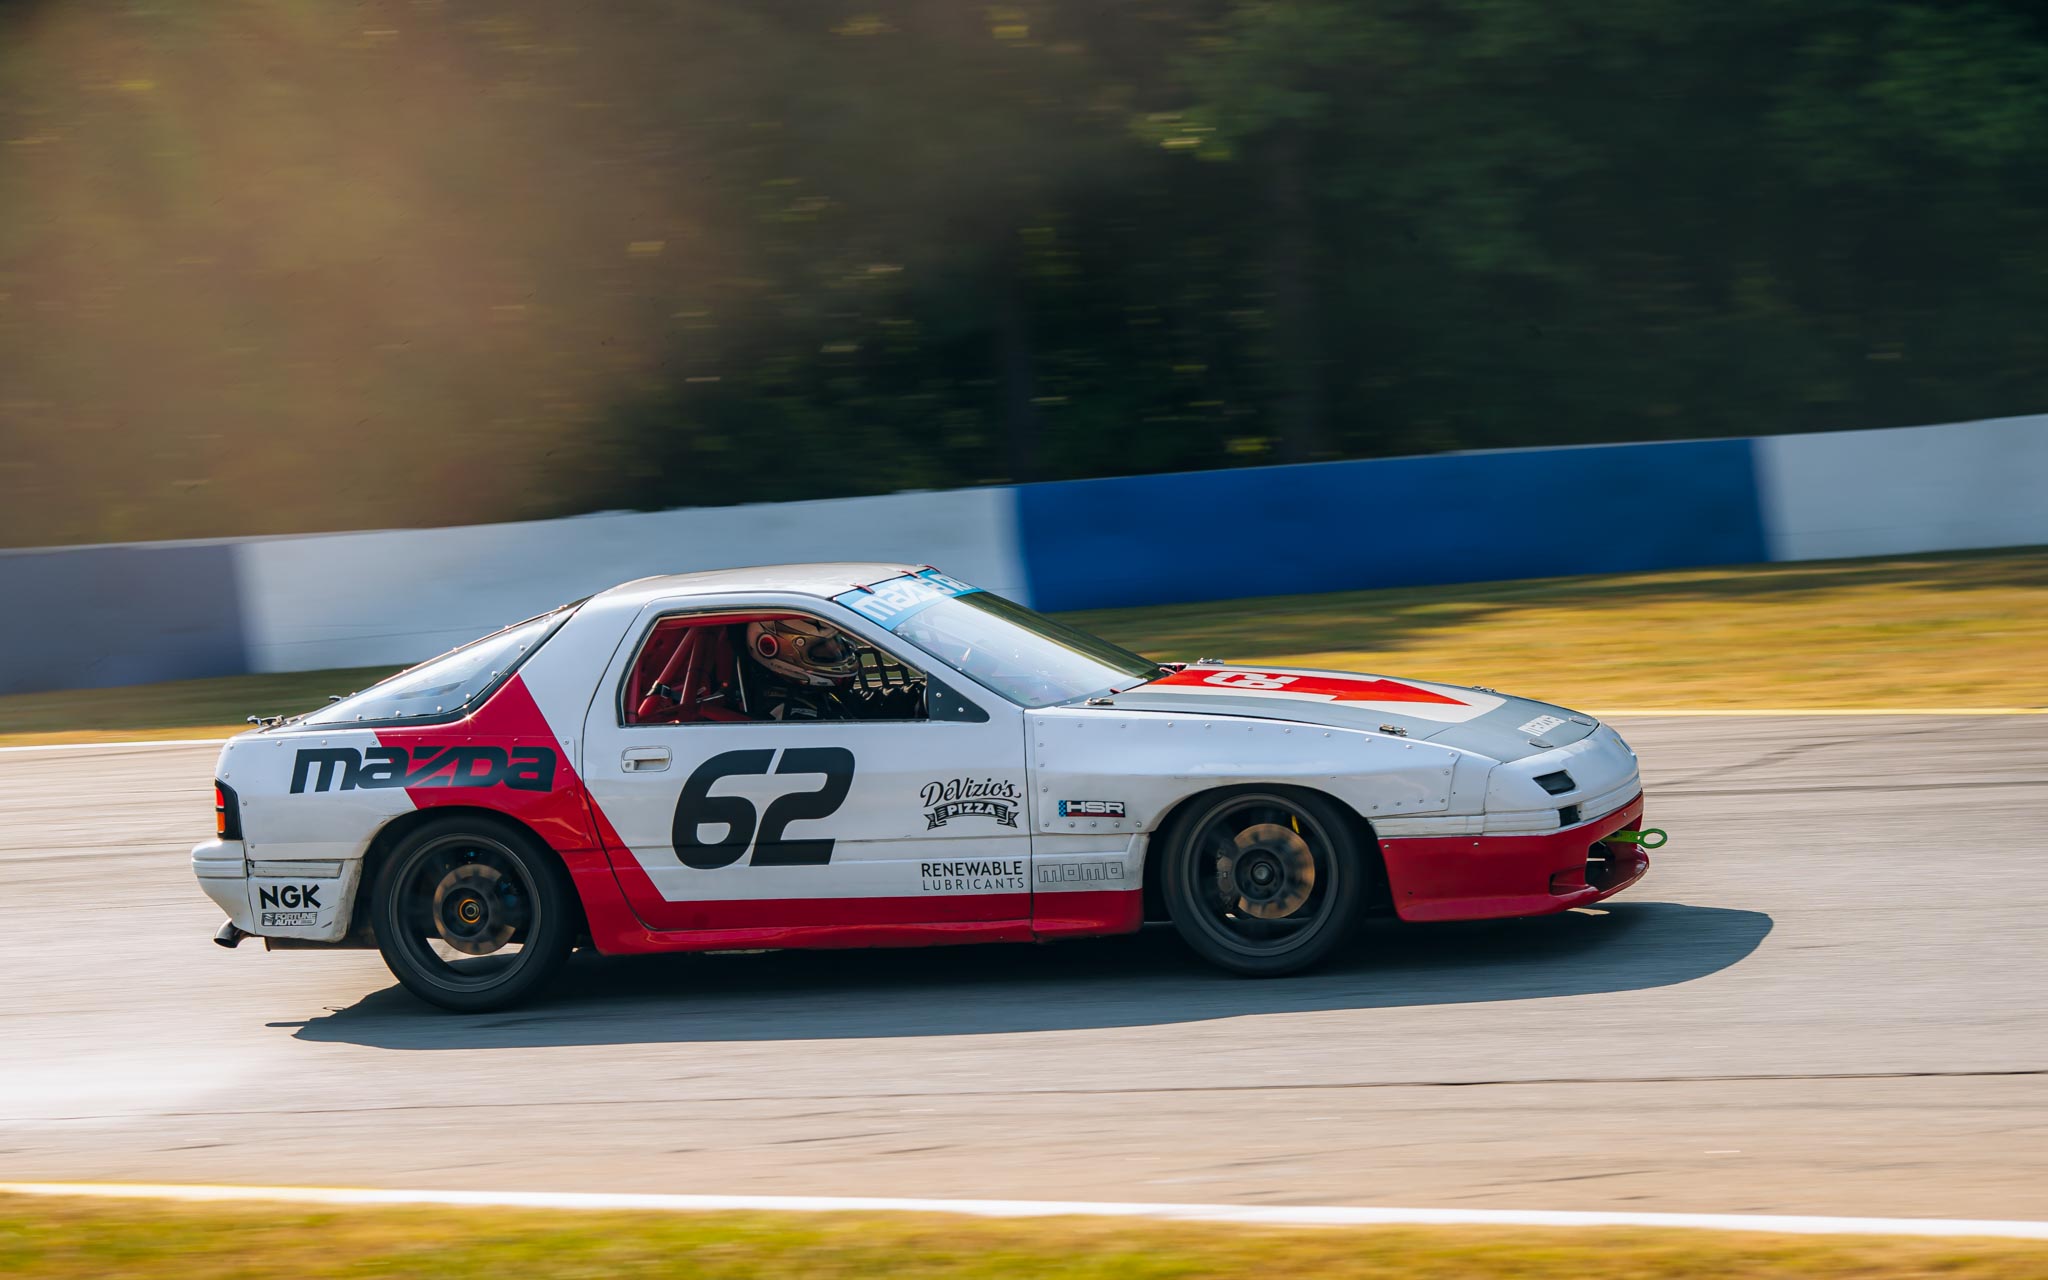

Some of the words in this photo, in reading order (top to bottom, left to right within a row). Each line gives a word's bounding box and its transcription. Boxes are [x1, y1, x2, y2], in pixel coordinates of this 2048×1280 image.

[1203, 671, 1301, 690] 62
[289, 745, 557, 794] mazda
[920, 777, 1022, 808] DeVizio's
[672, 746, 855, 870] 62
[947, 802, 996, 816] PIZZA
[1066, 801, 1124, 814] HSR
[921, 860, 1023, 878] RENEWABLE
[922, 877, 1024, 891] LUBRICANTS
[259, 884, 322, 909] NGK
[275, 912, 316, 920] FORTUNE
